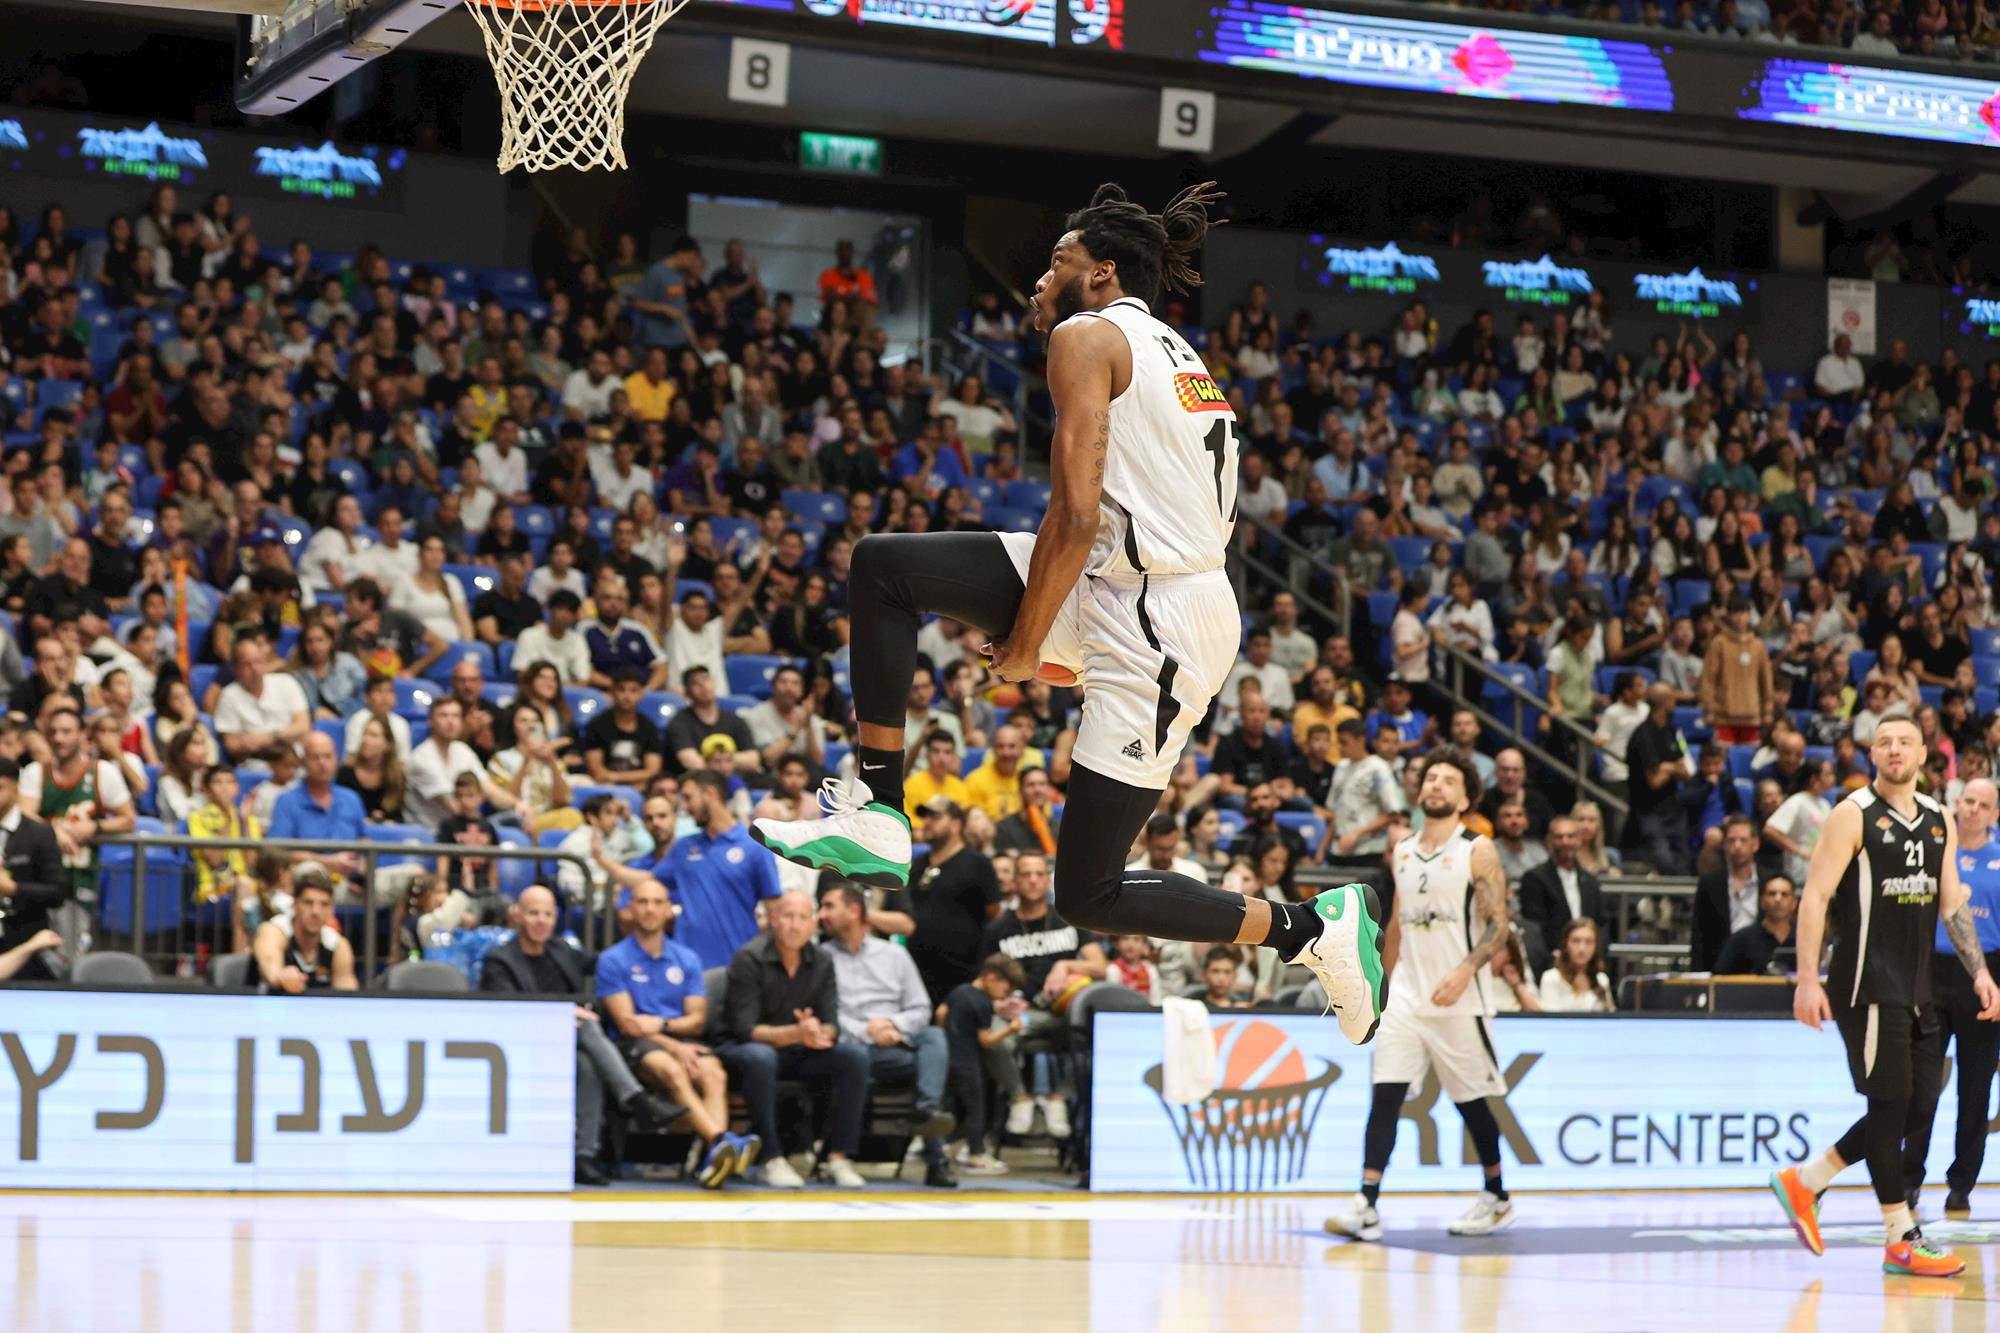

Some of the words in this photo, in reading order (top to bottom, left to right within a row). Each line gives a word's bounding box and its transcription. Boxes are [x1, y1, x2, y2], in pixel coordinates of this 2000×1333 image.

[746, 54, 771, 90] 8
[1174, 103, 1198, 136] 9
[1903, 839, 1925, 867] 21
[1418, 873, 1428, 894] 2
[0, 1031, 167, 1162] כץ
[234, 1036, 507, 1164] רענן
[1557, 1113, 1812, 1166] CENTERS
